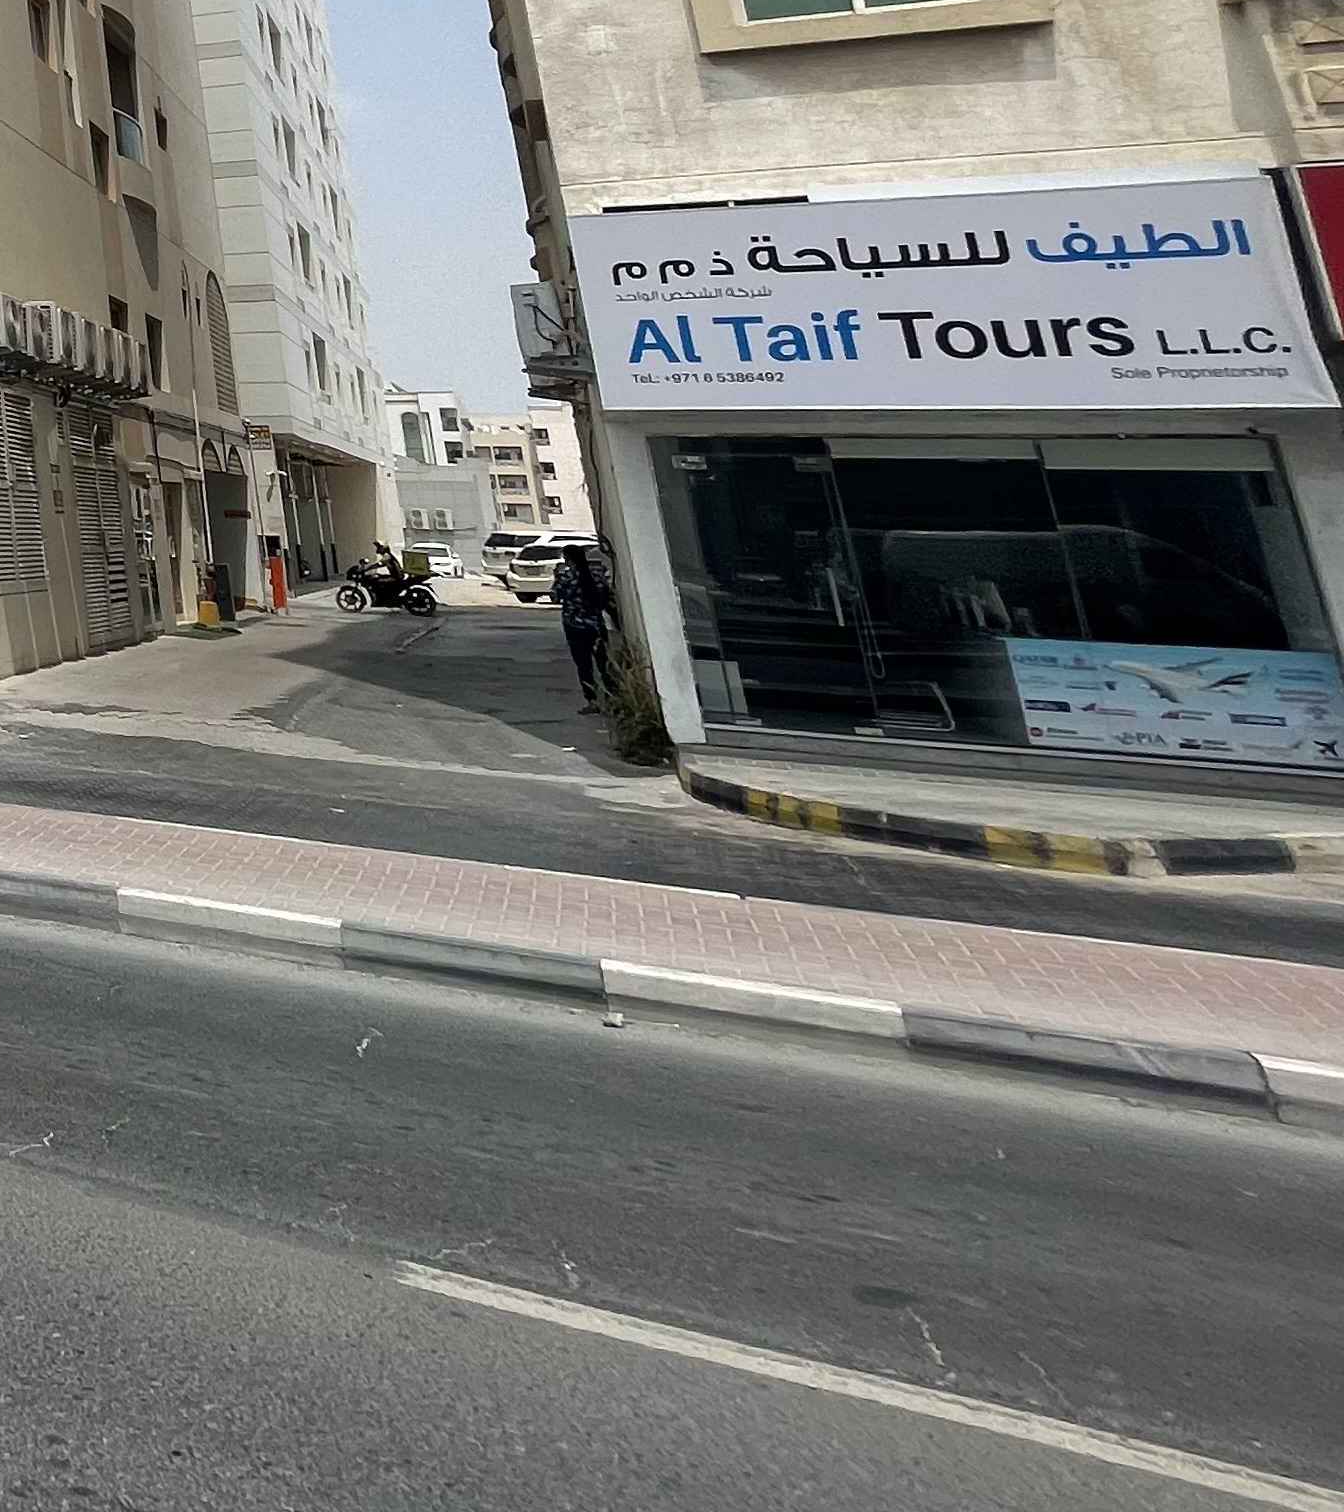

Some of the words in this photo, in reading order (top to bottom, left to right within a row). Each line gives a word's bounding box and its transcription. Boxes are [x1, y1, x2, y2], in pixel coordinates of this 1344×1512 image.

[746, 229, 1011, 279] للسياحة
[1025, 219, 1252, 270] الطيف
[661, 287, 723, 302] الشخص
[726, 284, 772, 299] شركة
[628, 315, 702, 364] Al
[712, 309, 861, 363] Taif
[878, 311, 1135, 360] Tours
[1155, 326, 1293, 355] L.L.C.
[1111, 366, 1153, 380] Sole
